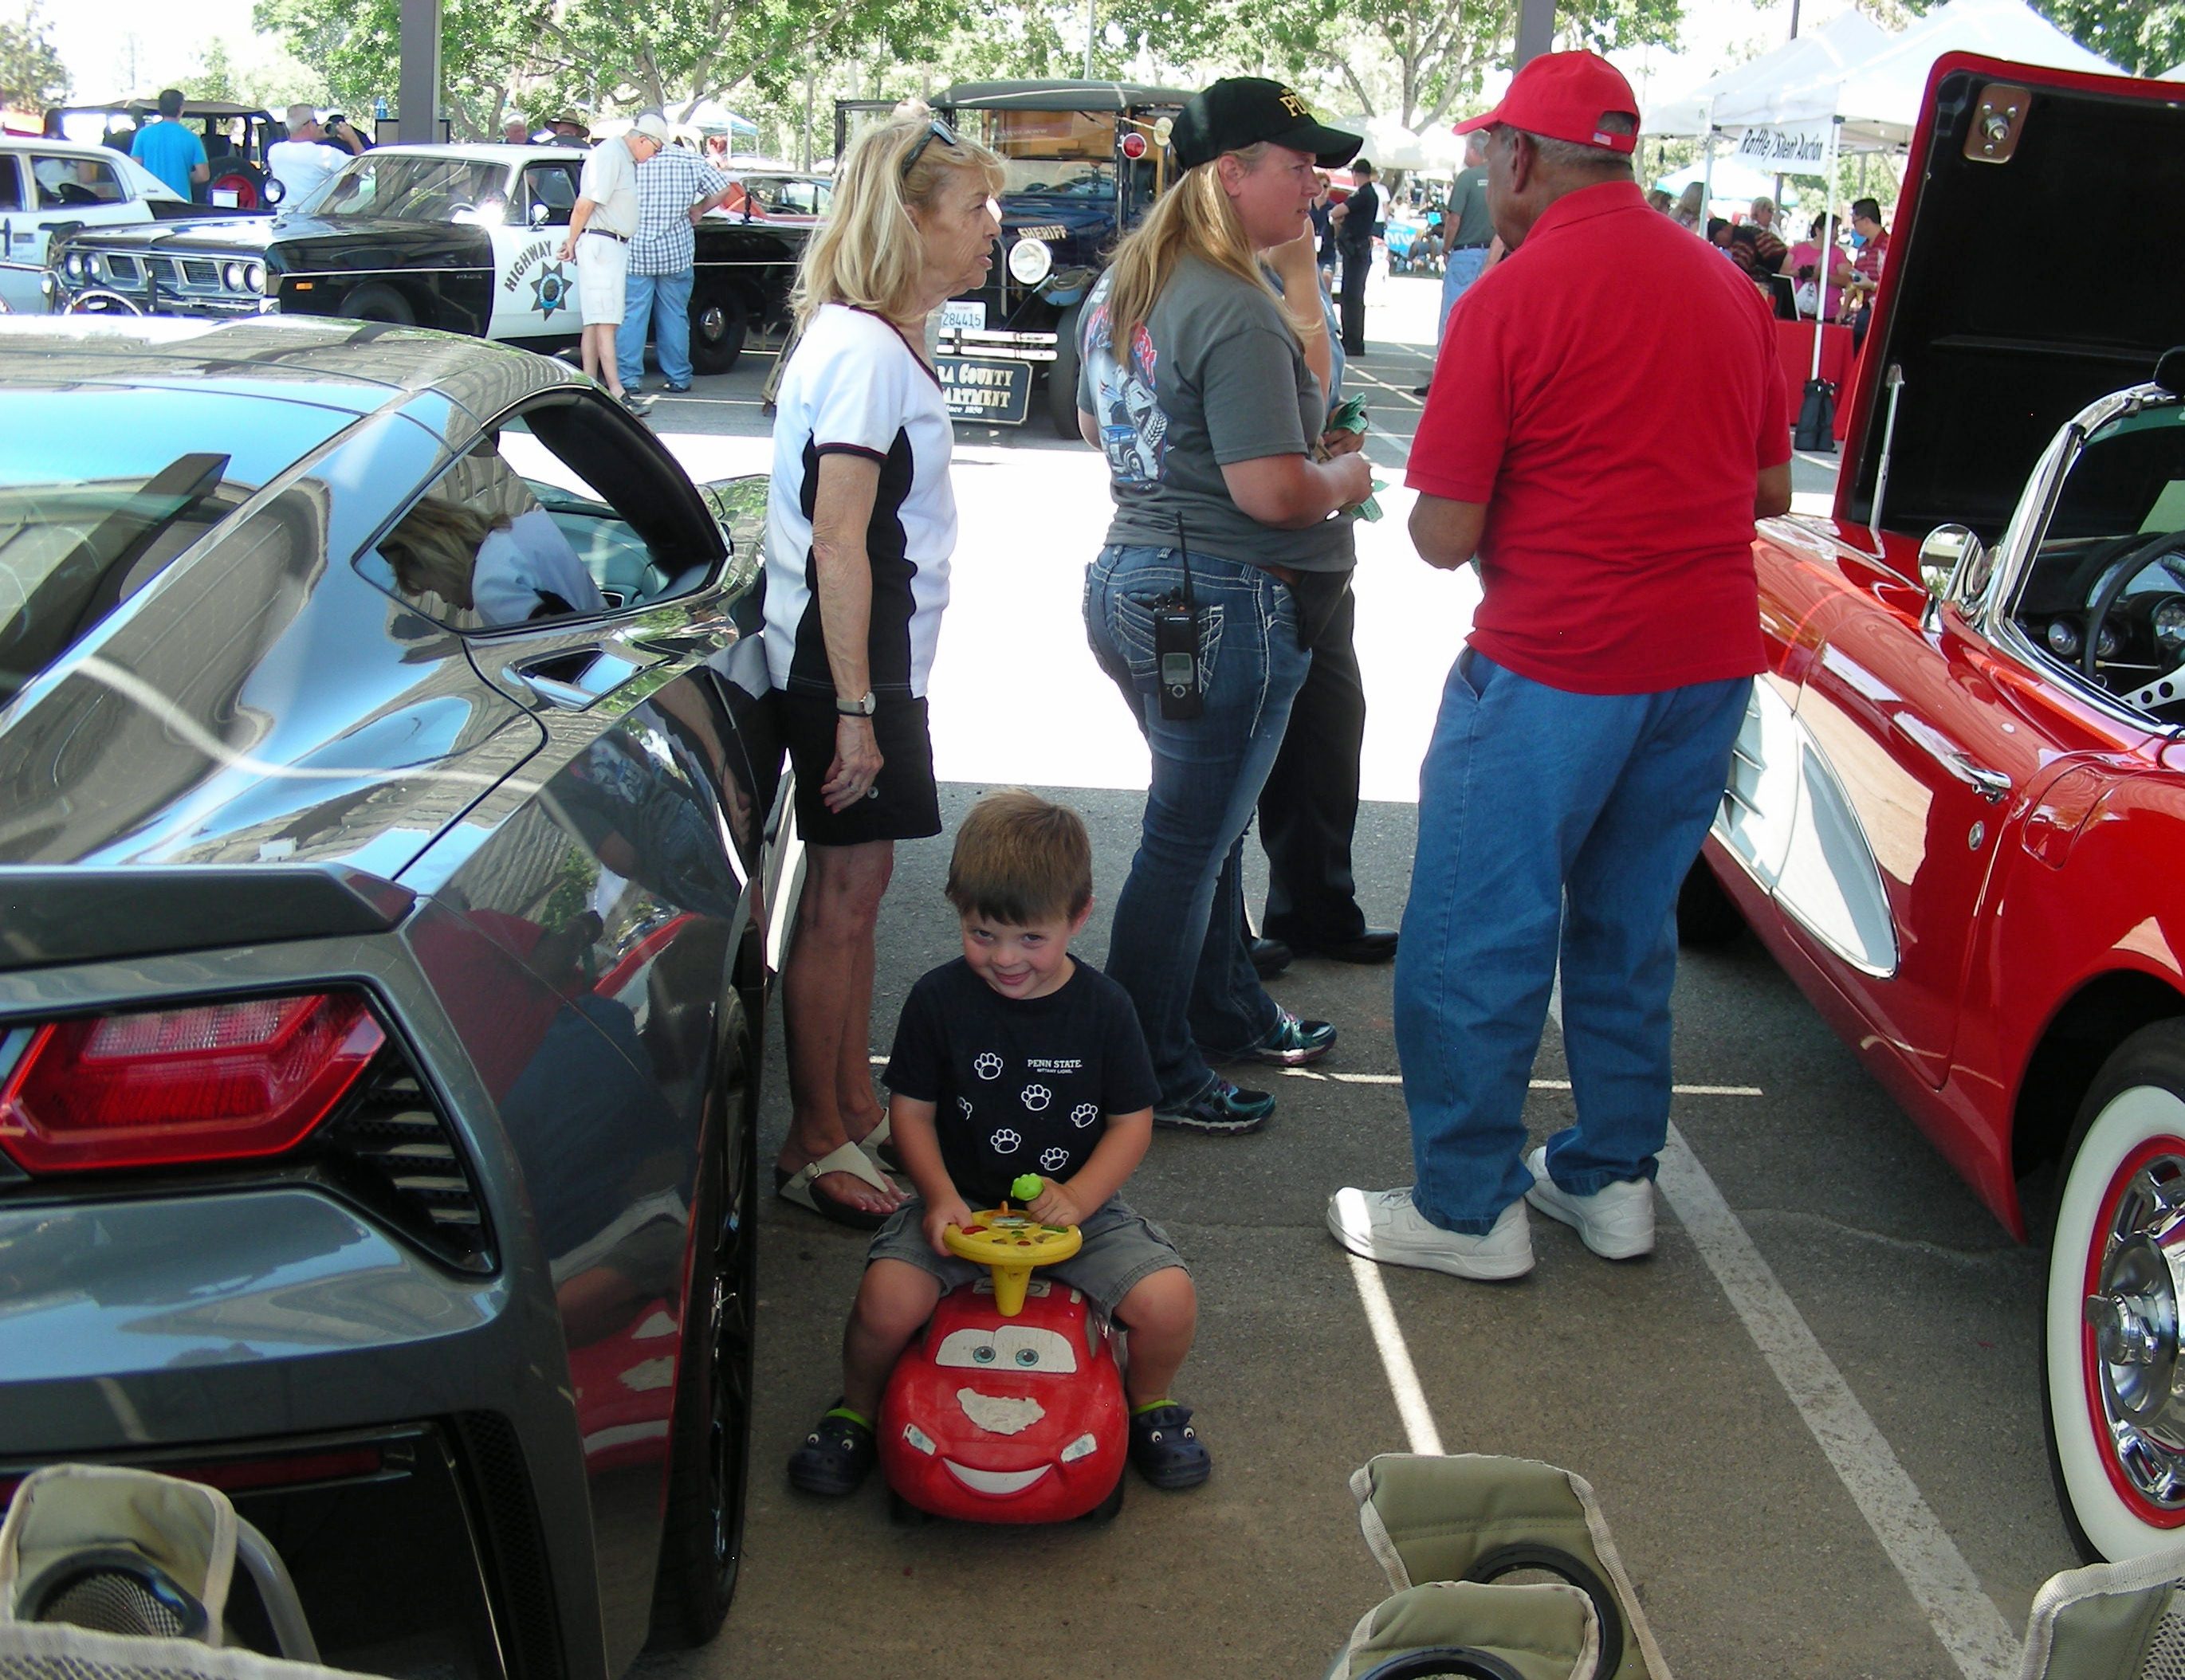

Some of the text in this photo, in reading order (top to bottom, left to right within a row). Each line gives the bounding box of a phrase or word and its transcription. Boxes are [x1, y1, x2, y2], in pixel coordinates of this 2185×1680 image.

[1017, 225, 1067, 240] SHERIFF
[504, 240, 552, 292] HIGHWAY
[943, 312, 981, 327] 284415
[937, 365, 954, 383] RA
[943, 387, 1011, 408] ARTMENT
[1027, 1058, 1082, 1069] PENN STATE
